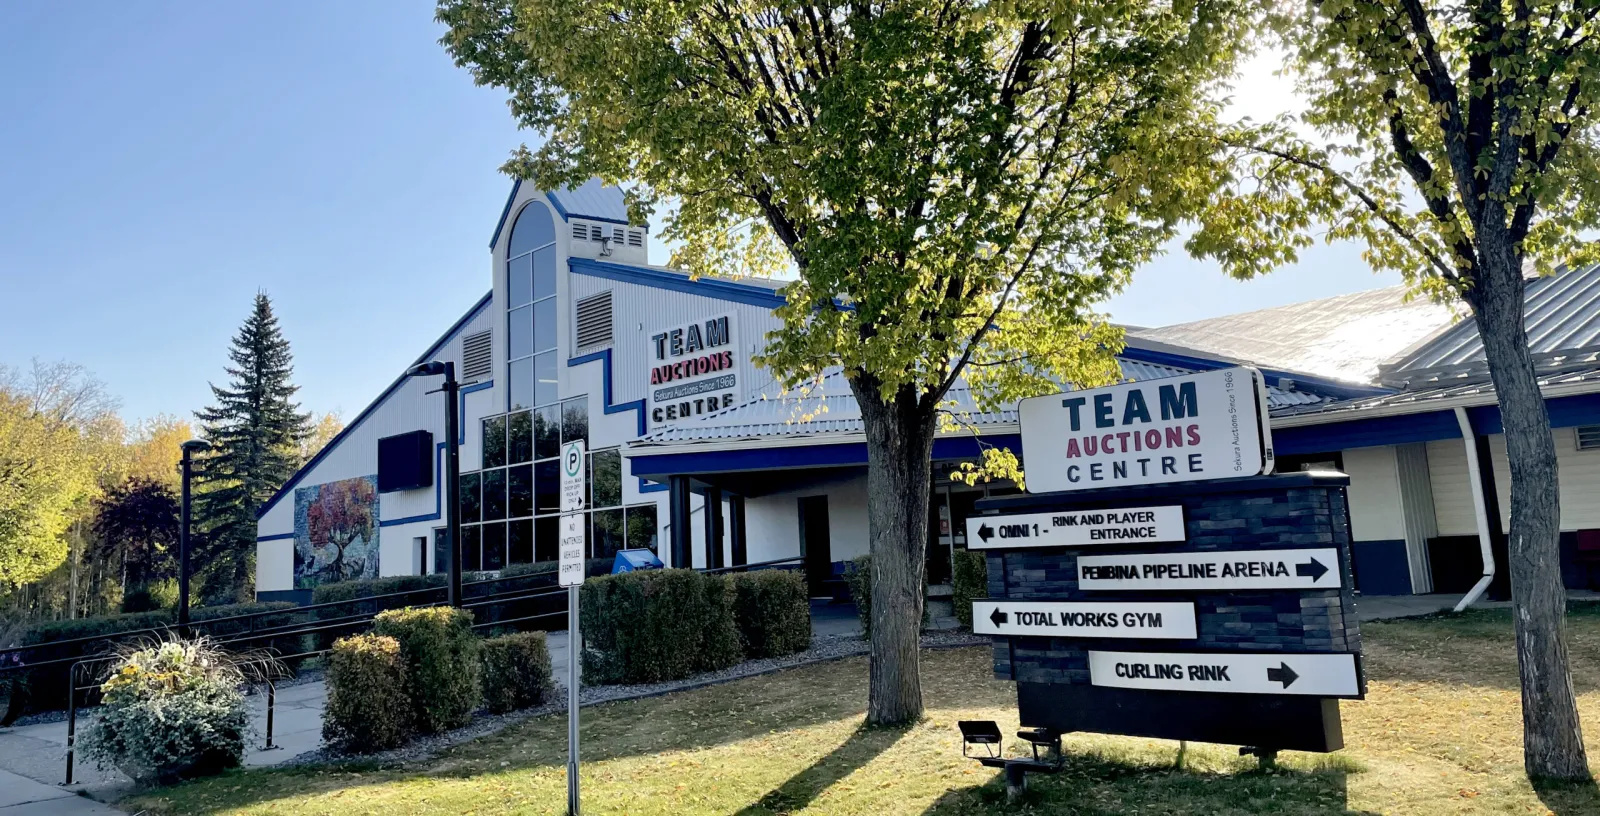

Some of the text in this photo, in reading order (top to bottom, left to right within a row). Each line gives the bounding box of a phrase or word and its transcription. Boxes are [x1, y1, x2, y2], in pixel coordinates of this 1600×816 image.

[652, 316, 729, 359] TEAM
[651, 351, 732, 384] AUCTIONS
[674, 384, 699, 397] Auctions
[699, 381, 715, 392] Since
[716, 375, 735, 388] 1966
[652, 393, 734, 422] CENTRE
[1062, 381, 1199, 432] TEAM
[1225, 371, 1242, 472] Sekura Auctions Since 1966
[1066, 424, 1201, 459] AUCTIONS
[1067, 453, 1204, 483] CENTRE
[569, 523, 576, 532] NO
[1052, 511, 1155, 527] RINK AND PLAYER
[561, 535, 583, 546] UNATTENDED
[998, 524, 1030, 539] OMNI
[1033, 524, 1039, 537] 1
[1090, 526, 1157, 540] ENTRANCE
[563, 549, 580, 559] VEHICLES
[562, 563, 581, 573] PERMITTED
[1081, 561, 1290, 580] PEMBINA PIPELINE ARENA
[1014, 611, 1163, 629] TOTAL WORKS GYM
[1115, 662, 1231, 683] CURLING RINK
